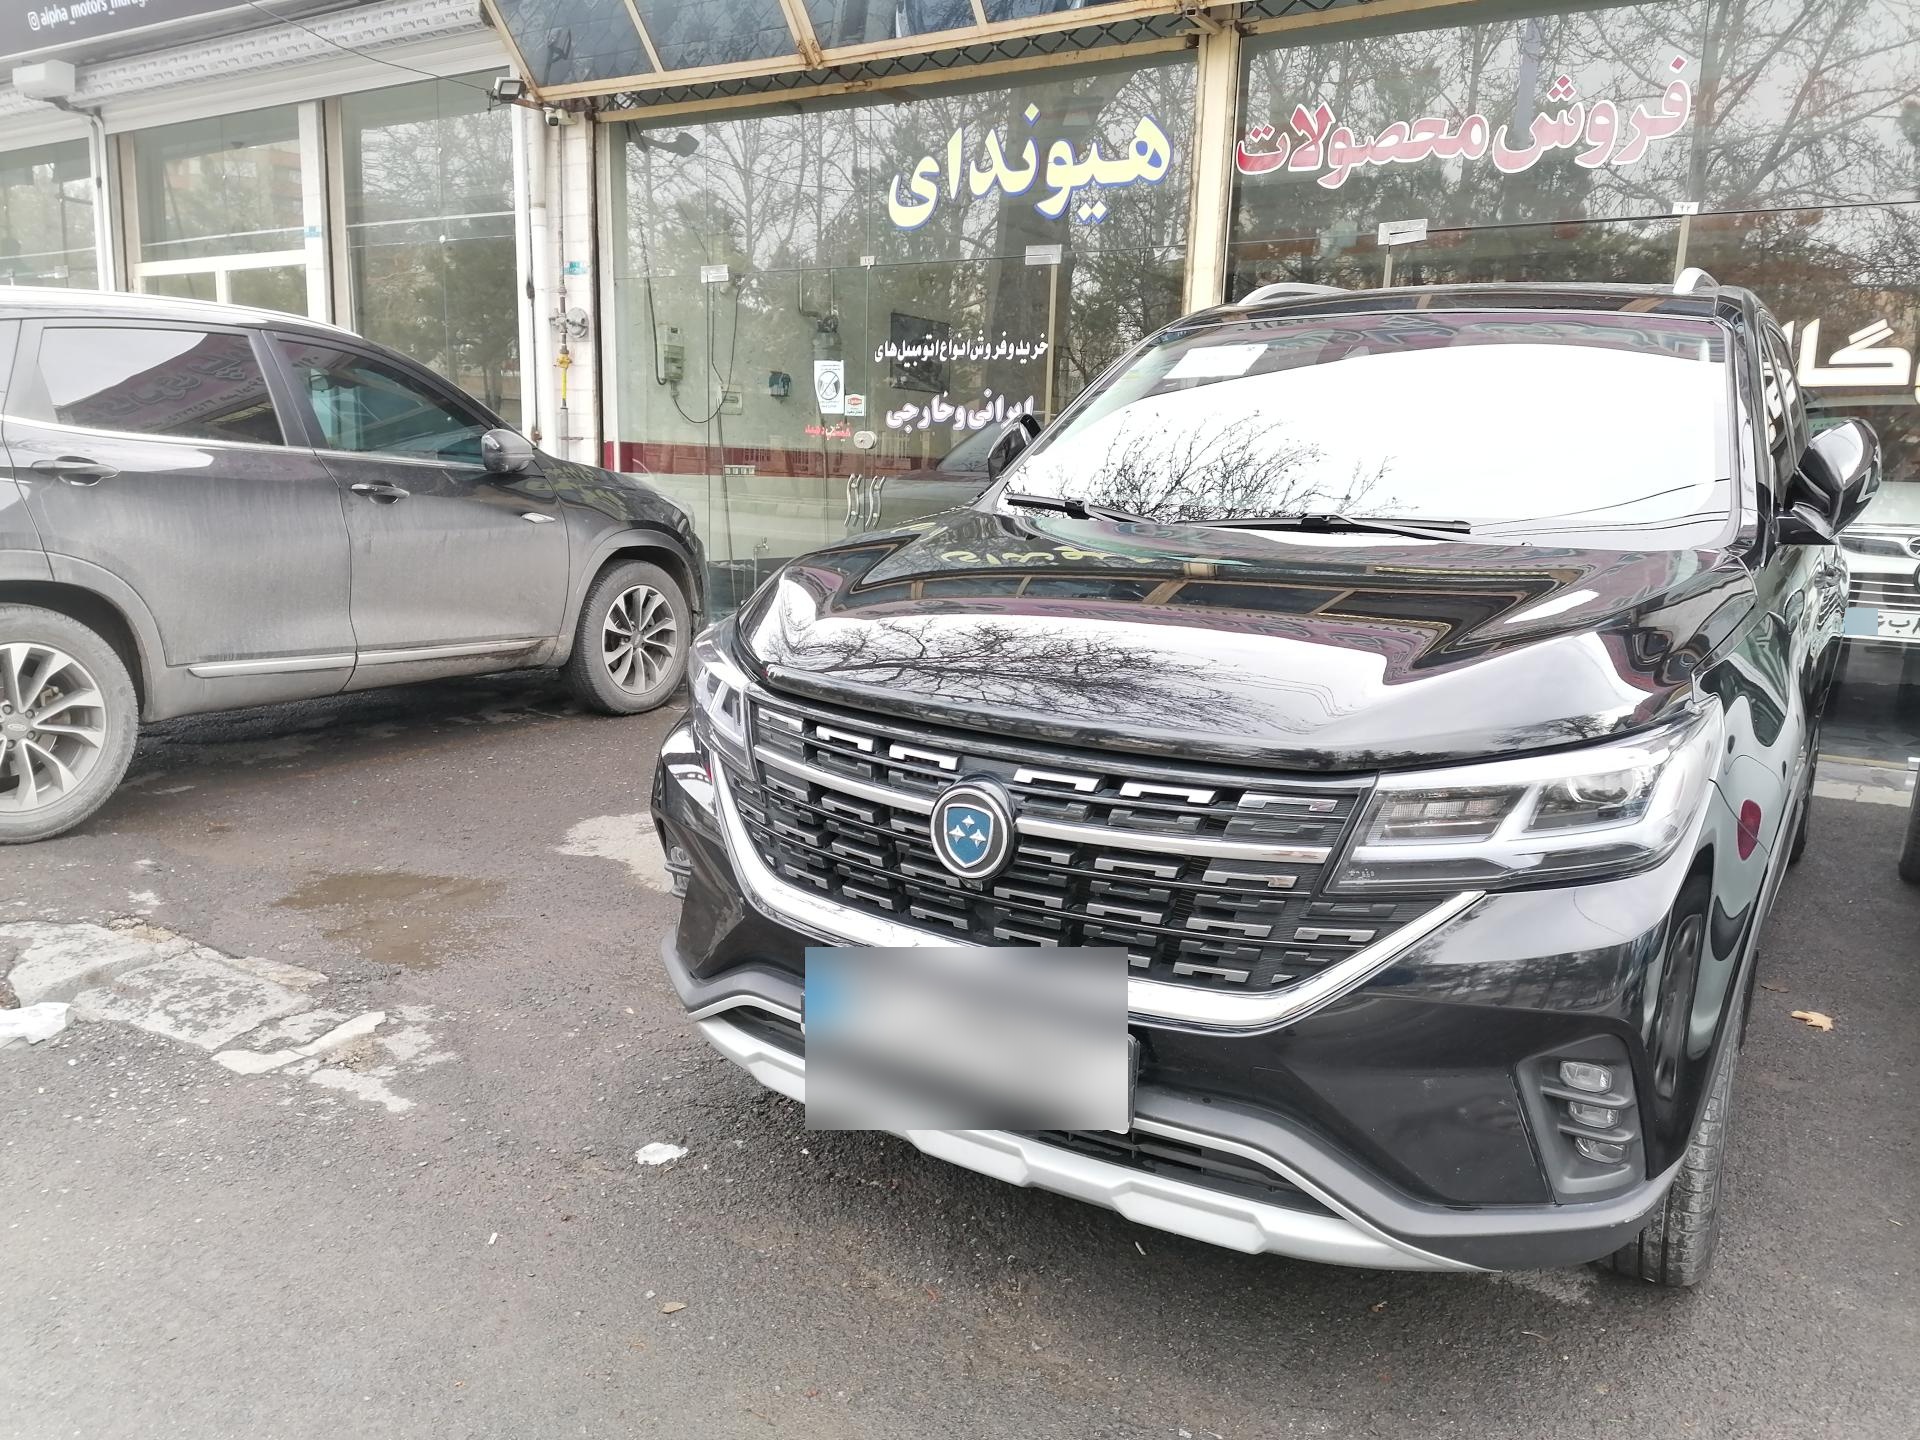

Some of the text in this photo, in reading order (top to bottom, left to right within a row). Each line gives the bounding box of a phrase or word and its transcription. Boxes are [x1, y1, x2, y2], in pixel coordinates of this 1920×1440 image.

[1236, 54, 1692, 190] فروش محصولات
[888, 102, 1173, 231] هیوندای
[940, 333, 970, 361] انواع
[970, 330, 1007, 361] فروش
[1016, 332, 1049, 364] خرید
[886, 390, 955, 434] خارجی
